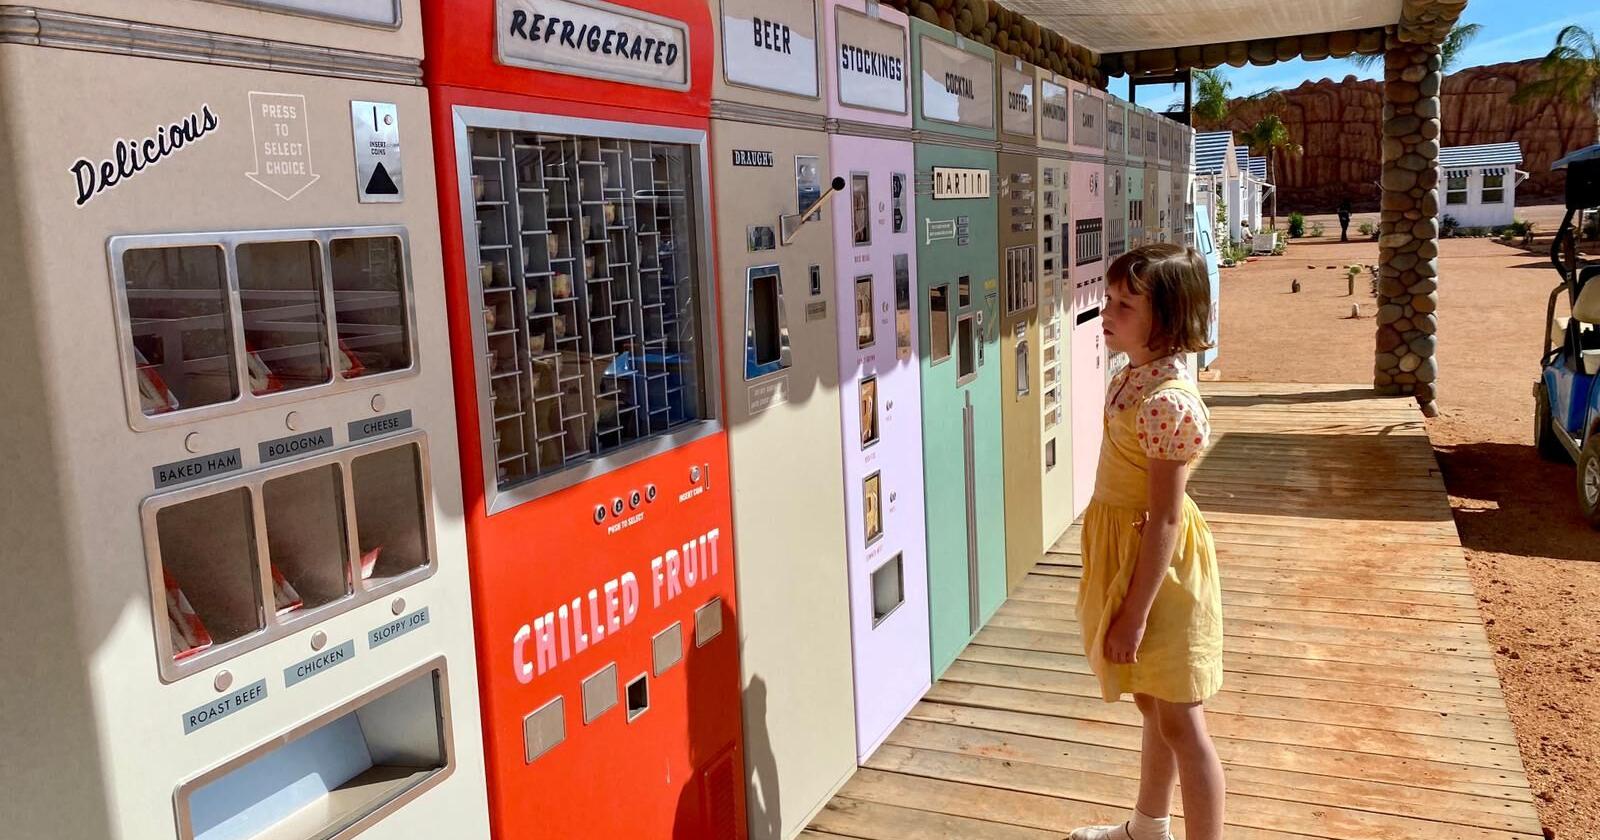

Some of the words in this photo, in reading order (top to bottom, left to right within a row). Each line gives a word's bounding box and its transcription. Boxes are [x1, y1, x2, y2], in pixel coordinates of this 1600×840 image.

[510, 9, 678, 66] REFRIGERATED
[753, 16, 791, 55] BEER
[841, 43, 902, 81] STOCKINGS
[945, 72, 974, 100] COCKTAIL
[261, 103, 297, 119] PRESS
[1008, 91, 1028, 113] COFFEE
[274, 123, 289, 137] TO
[70, 104, 218, 206] Delicious
[264, 141, 303, 157] SELECT
[371, 148, 386, 156] COINS
[735, 151, 773, 166] DRAUGHT
[266, 160, 306, 176] CHOICE
[936, 172, 988, 194] MARTINI
[363, 417, 399, 434] CHEESE
[268, 435, 325, 457] BOLOGNA
[159, 462, 203, 483] BAKED
[207, 454, 237, 472] HAM
[512, 571, 640, 685] CHILLED
[651, 528, 720, 609] FRUIT
[373, 619, 406, 643] SLOPPY
[408, 612, 426, 630] JOE
[296, 648, 344, 678] CHICKEN
[189, 699, 231, 727] ROAST
[235, 685, 263, 706] BEEF
